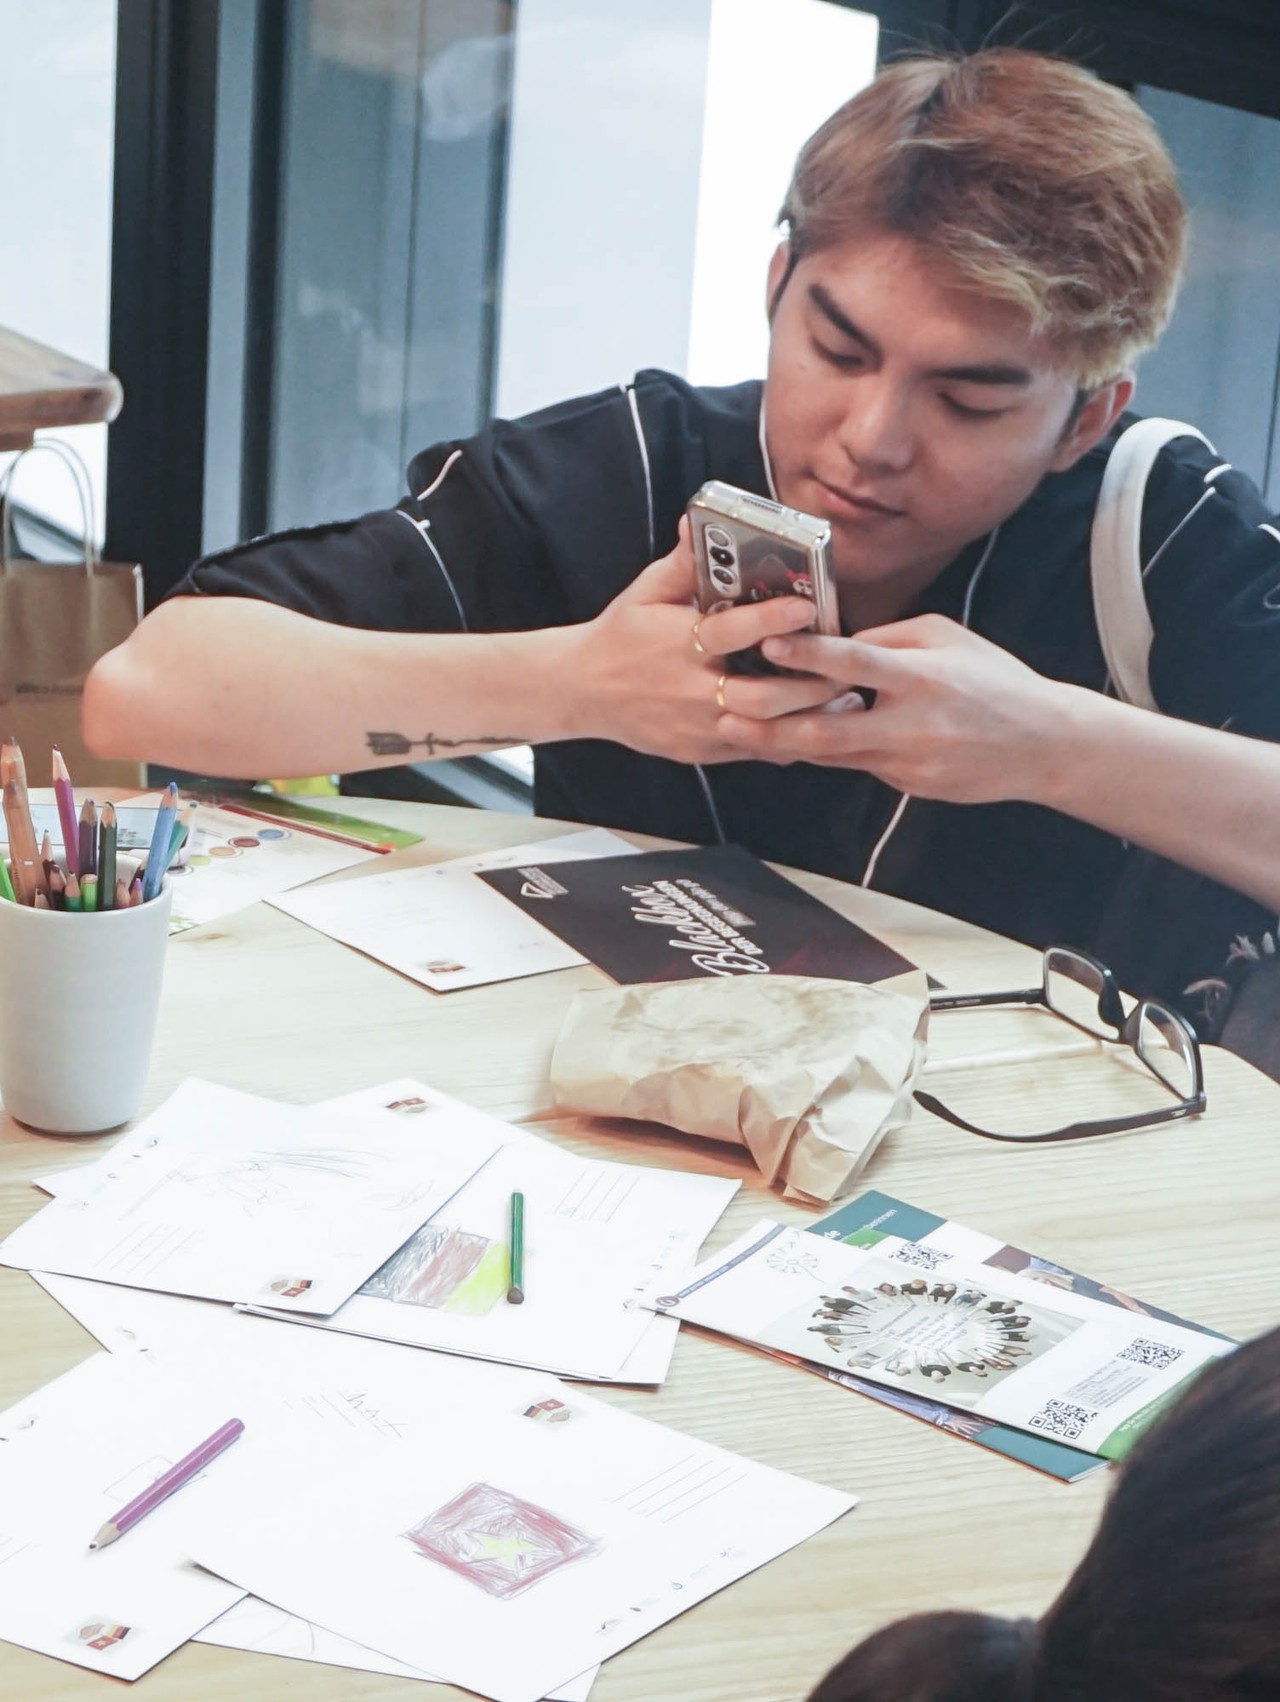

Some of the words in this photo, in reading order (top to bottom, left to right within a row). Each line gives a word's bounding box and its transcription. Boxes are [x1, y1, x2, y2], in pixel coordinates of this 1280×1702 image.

[621, 884, 770, 977] Blackbox
[652, 881, 740, 938] BEGEGNUNGEN
[731, 937, 764, 955] DER
